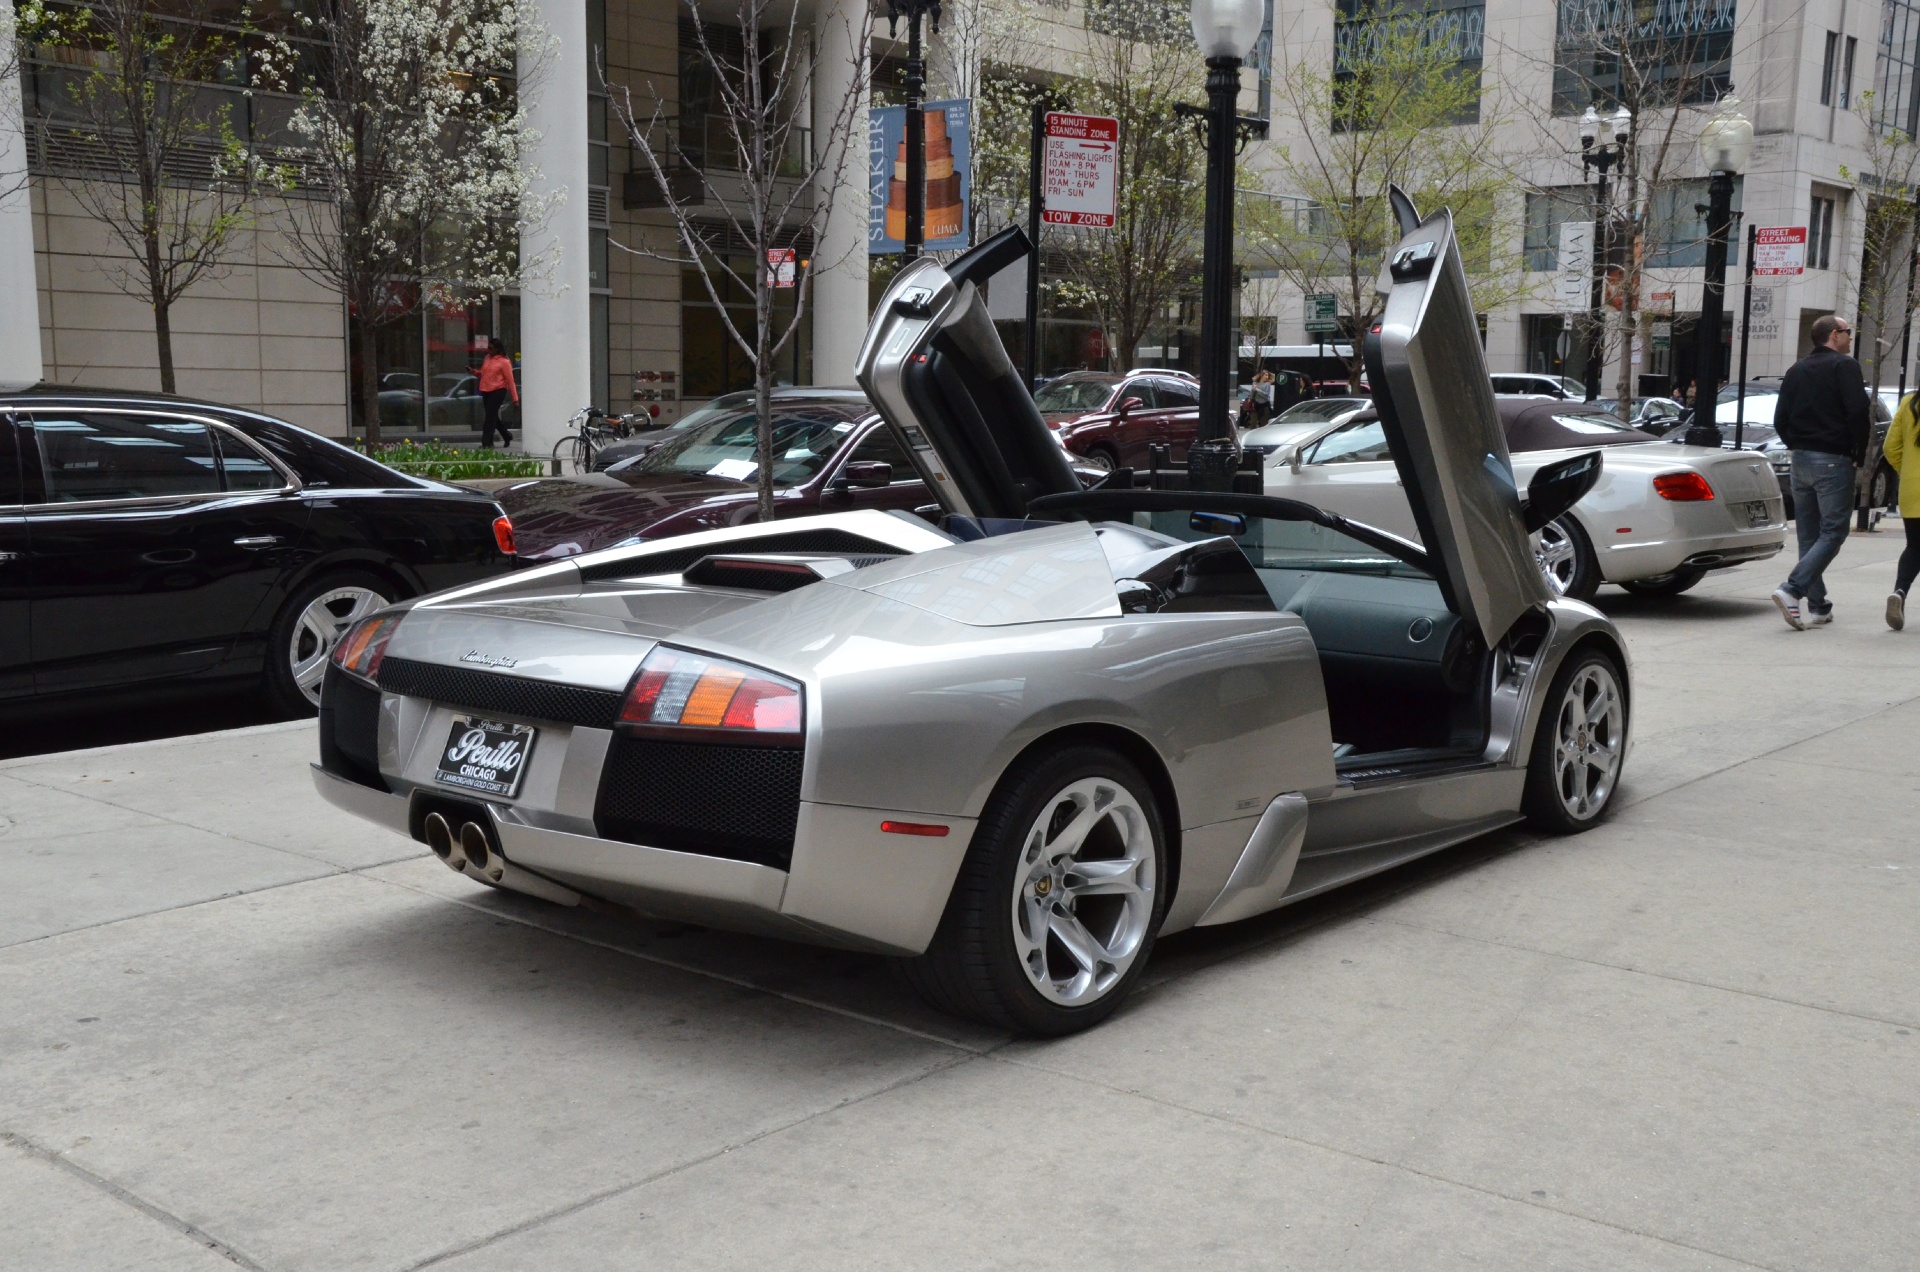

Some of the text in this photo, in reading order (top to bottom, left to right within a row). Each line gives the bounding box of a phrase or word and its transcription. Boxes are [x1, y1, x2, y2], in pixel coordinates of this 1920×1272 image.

[1051, 116, 1088, 127] 15 MINUTE
[1051, 126, 1110, 138] STANDING ZONE
[1050, 141, 1064, 149] USE
[1050, 150, 1112, 162] FLASHING LIGHTS
[1086, 162, 1096, 170] PM
[869, 116, 884, 241] SHAKER
[1049, 168, 1065, 177] MON
[1074, 170, 1099, 180] THURS
[1084, 180, 1094, 188] PM
[1068, 188, 1083, 197] SUN
[1047, 211, 1108, 225] TOW ZONE
[933, 224, 959, 235] LUMA
[458, 650, 518, 668] Lamborghini
[478, 720, 504, 731] Perillo
[448, 729, 520, 771] Perillo
[460, 765, 496, 780] CHICAGO
[443, 773, 501, 791] LAMBORGHINI GOLD COAST
